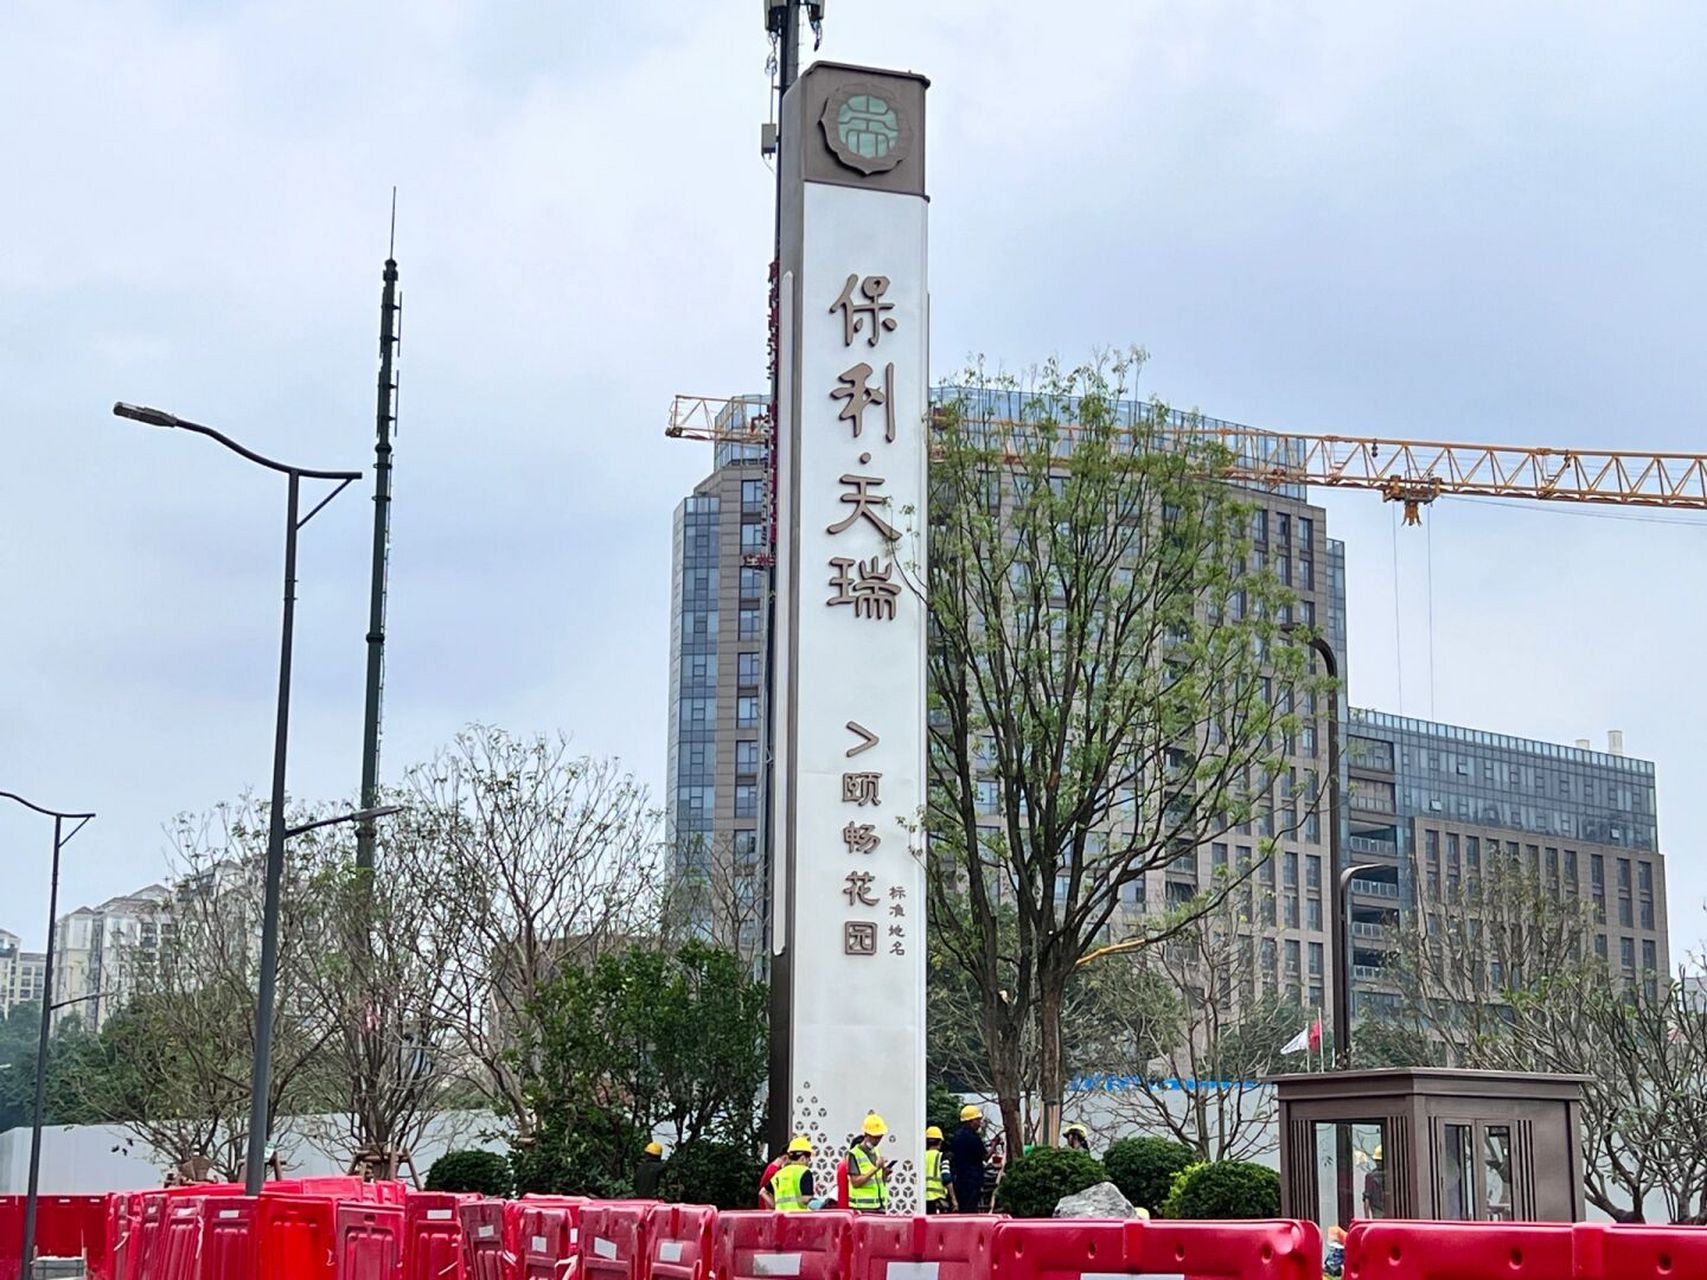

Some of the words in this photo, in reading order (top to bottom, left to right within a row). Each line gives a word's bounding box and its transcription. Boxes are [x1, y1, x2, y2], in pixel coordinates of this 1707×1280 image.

[827, 273, 902, 621] 保利·天瑞
[841, 771, 882, 956] 颐畅花园
[888, 886, 906, 957] 标准地名
